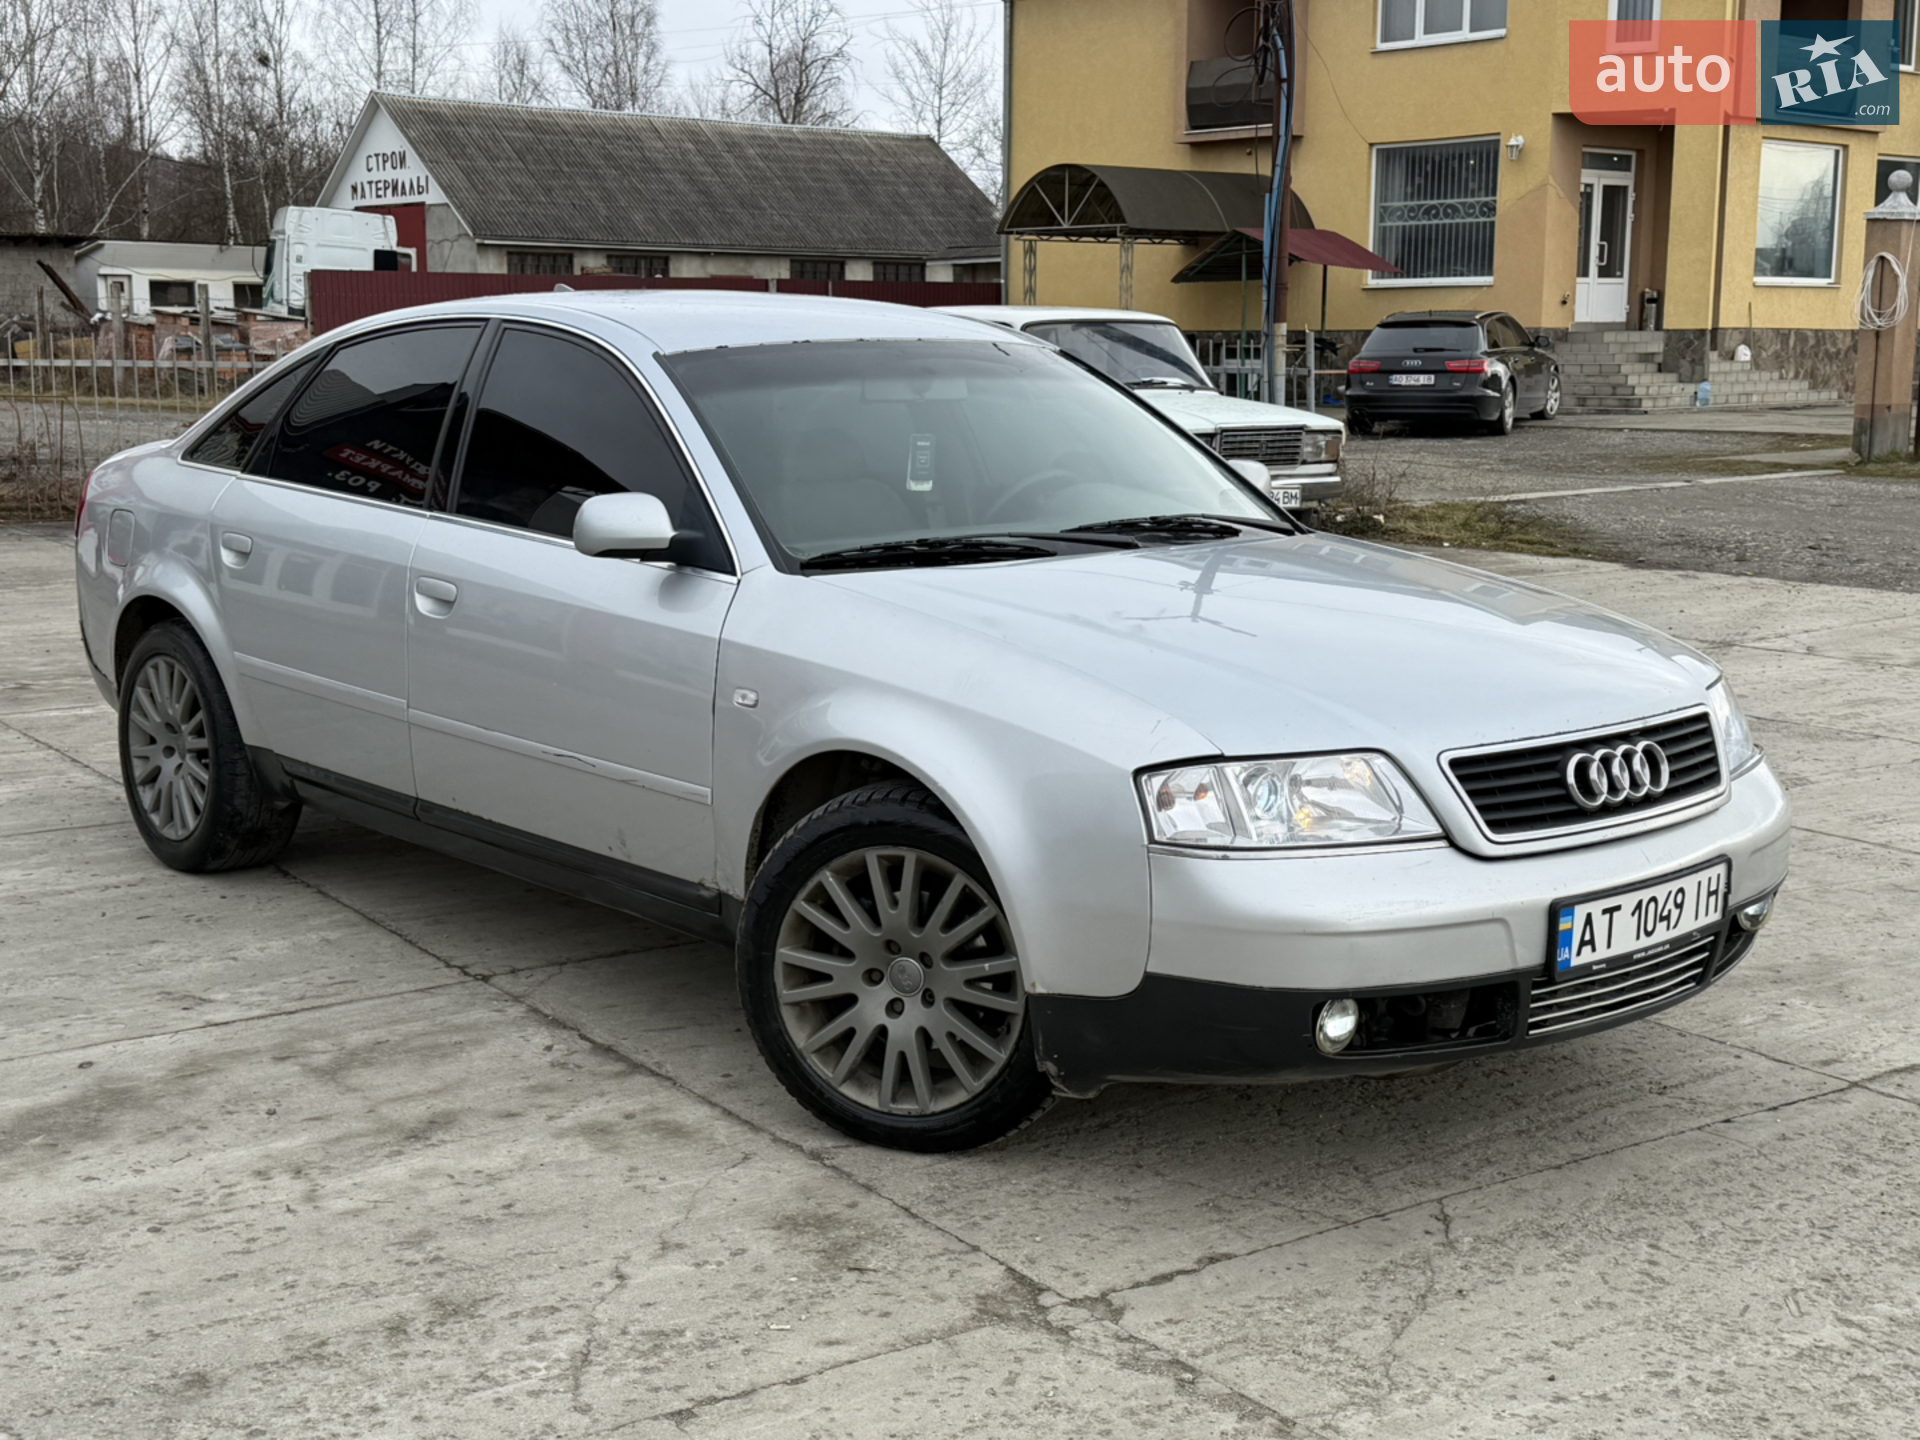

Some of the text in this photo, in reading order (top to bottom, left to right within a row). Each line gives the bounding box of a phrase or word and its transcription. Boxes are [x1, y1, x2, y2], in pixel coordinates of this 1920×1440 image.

[351, 174, 429, 201] МАТЕРИАЛЫ
[1576, 873, 1721, 957] AT 1049 IH
[1557, 946, 1570, 961] UA
